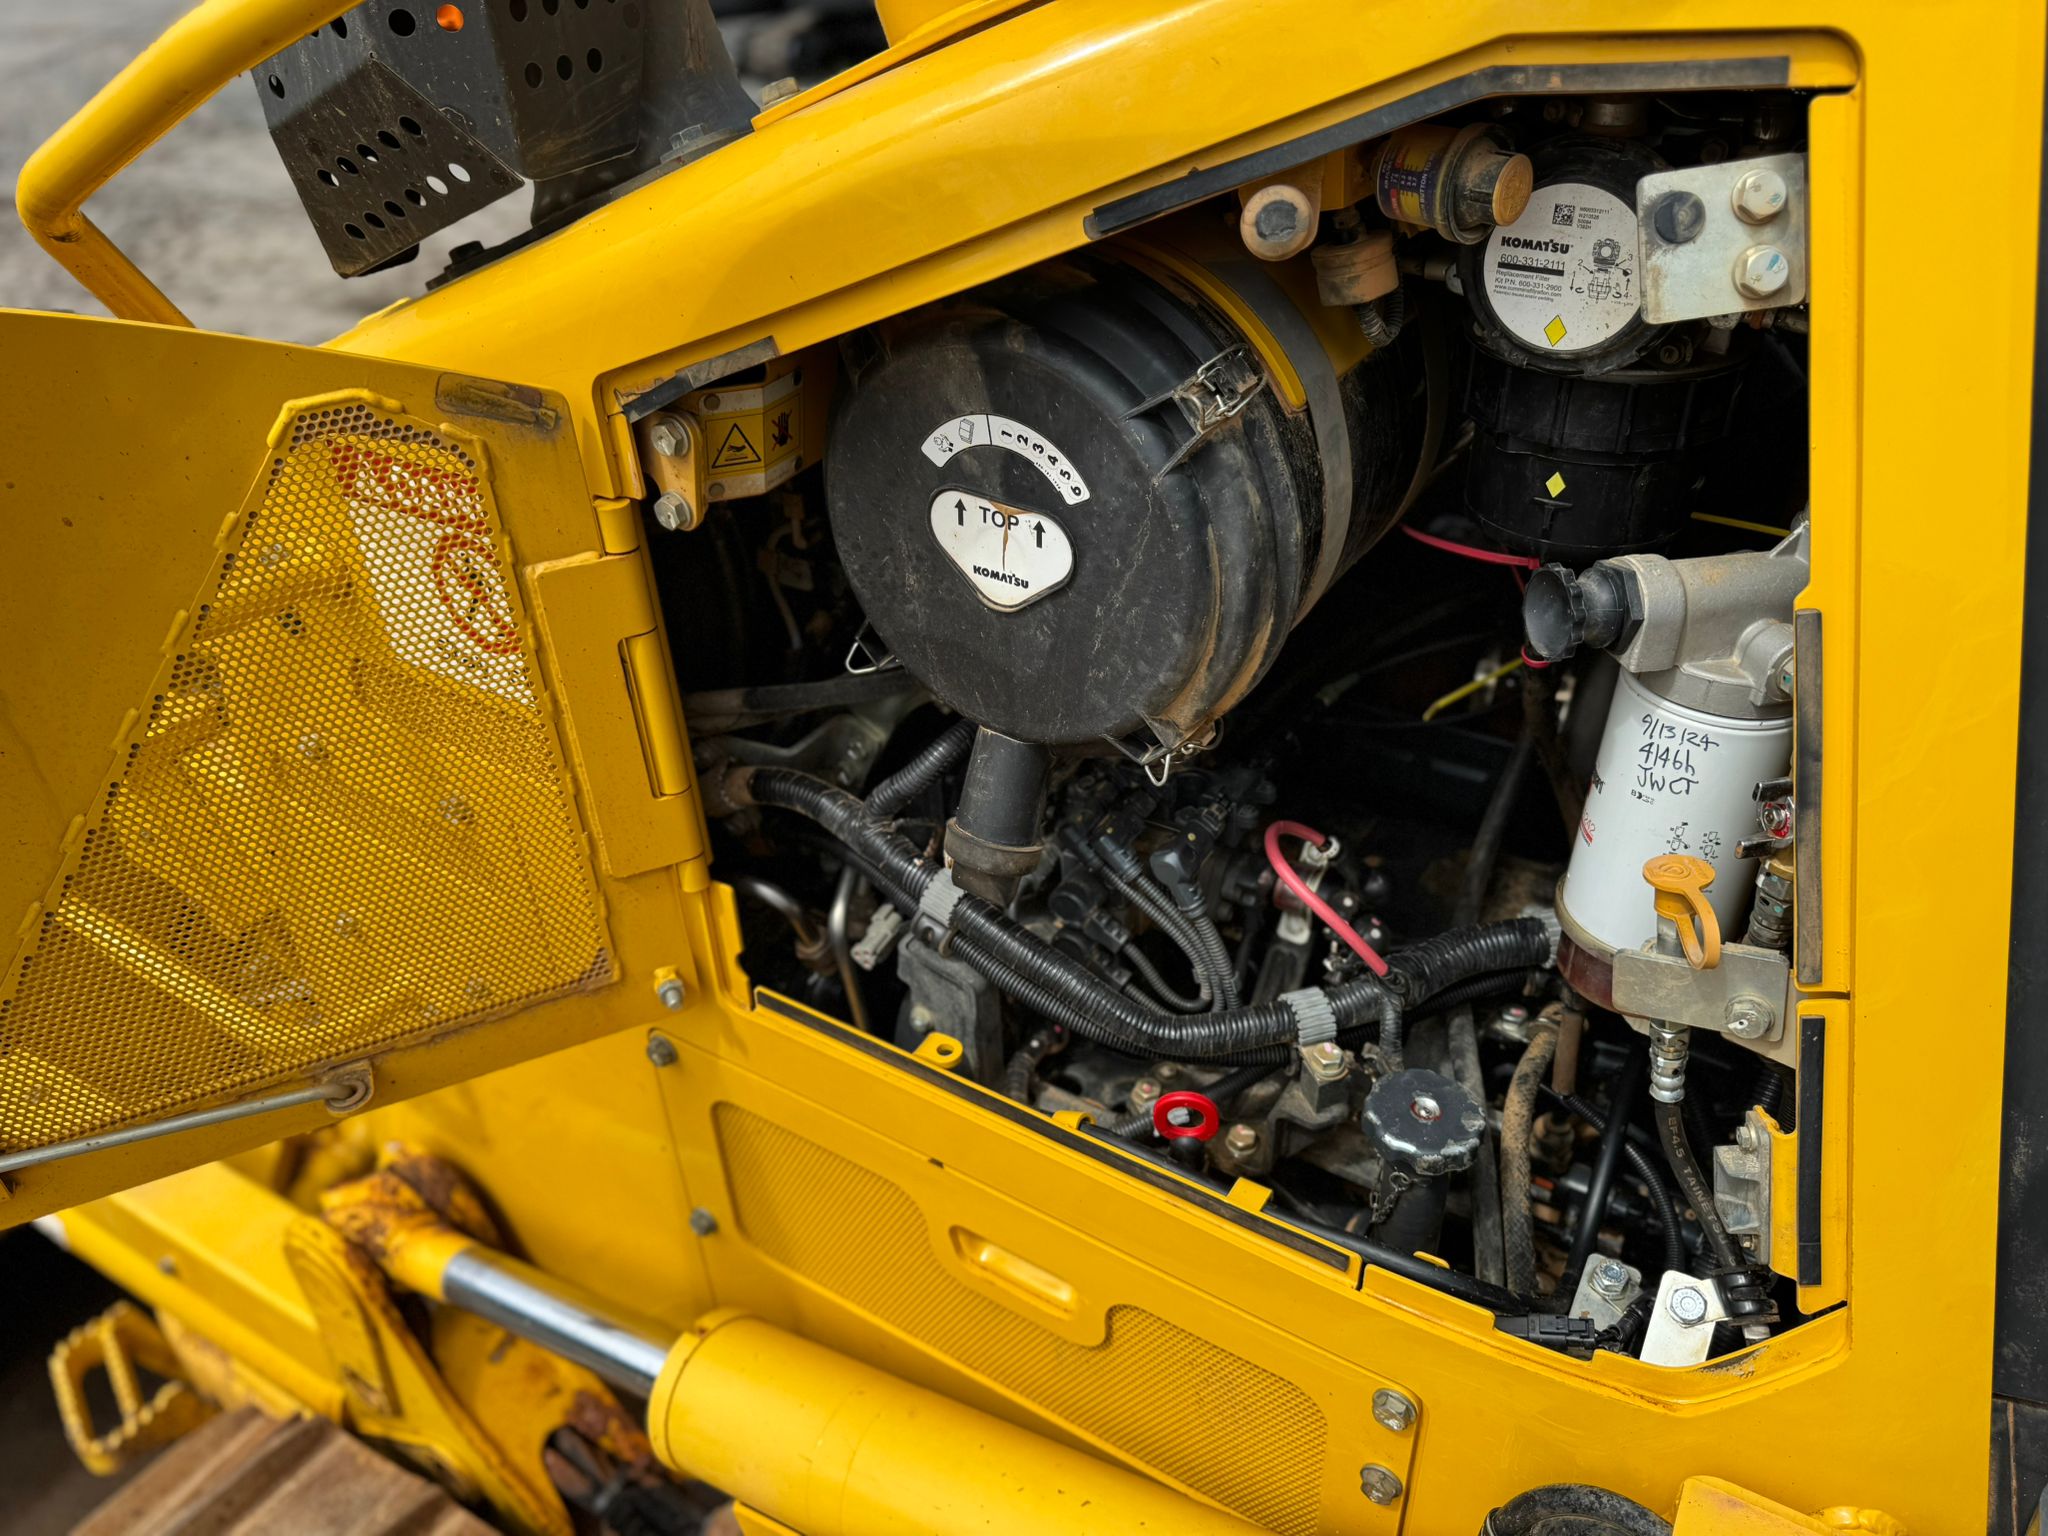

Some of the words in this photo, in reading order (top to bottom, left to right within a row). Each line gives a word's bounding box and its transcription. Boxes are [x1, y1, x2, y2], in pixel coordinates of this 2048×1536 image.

[1419, 172, 1429, 204] BUTTON
[1501, 236, 1570, 255] KOMATSU
[1500, 253, 1566, 270] 600-331-2111
[1577, 258, 1584, 267] 2
[1627, 253, 1634, 262] 3
[1494, 276, 1503, 285] Kit
[1495, 269, 1535, 281] Replacement
[1535, 274, 1551, 283] Filter
[1000, 429, 1013, 438] 1
[1016, 433, 1030, 446] 2
[1032, 442, 1045, 455] 3
[1047, 455, 1059, 467] 4
[1060, 468, 1071, 482] 5
[1070, 485, 1082, 498] 6
[978, 505, 1020, 531] TOP
[972, 564, 1030, 589] KOMATSU
[1641, 713, 1720, 751] 9/13/24
[1683, 1167, 1728, 1246] TAINETSU
